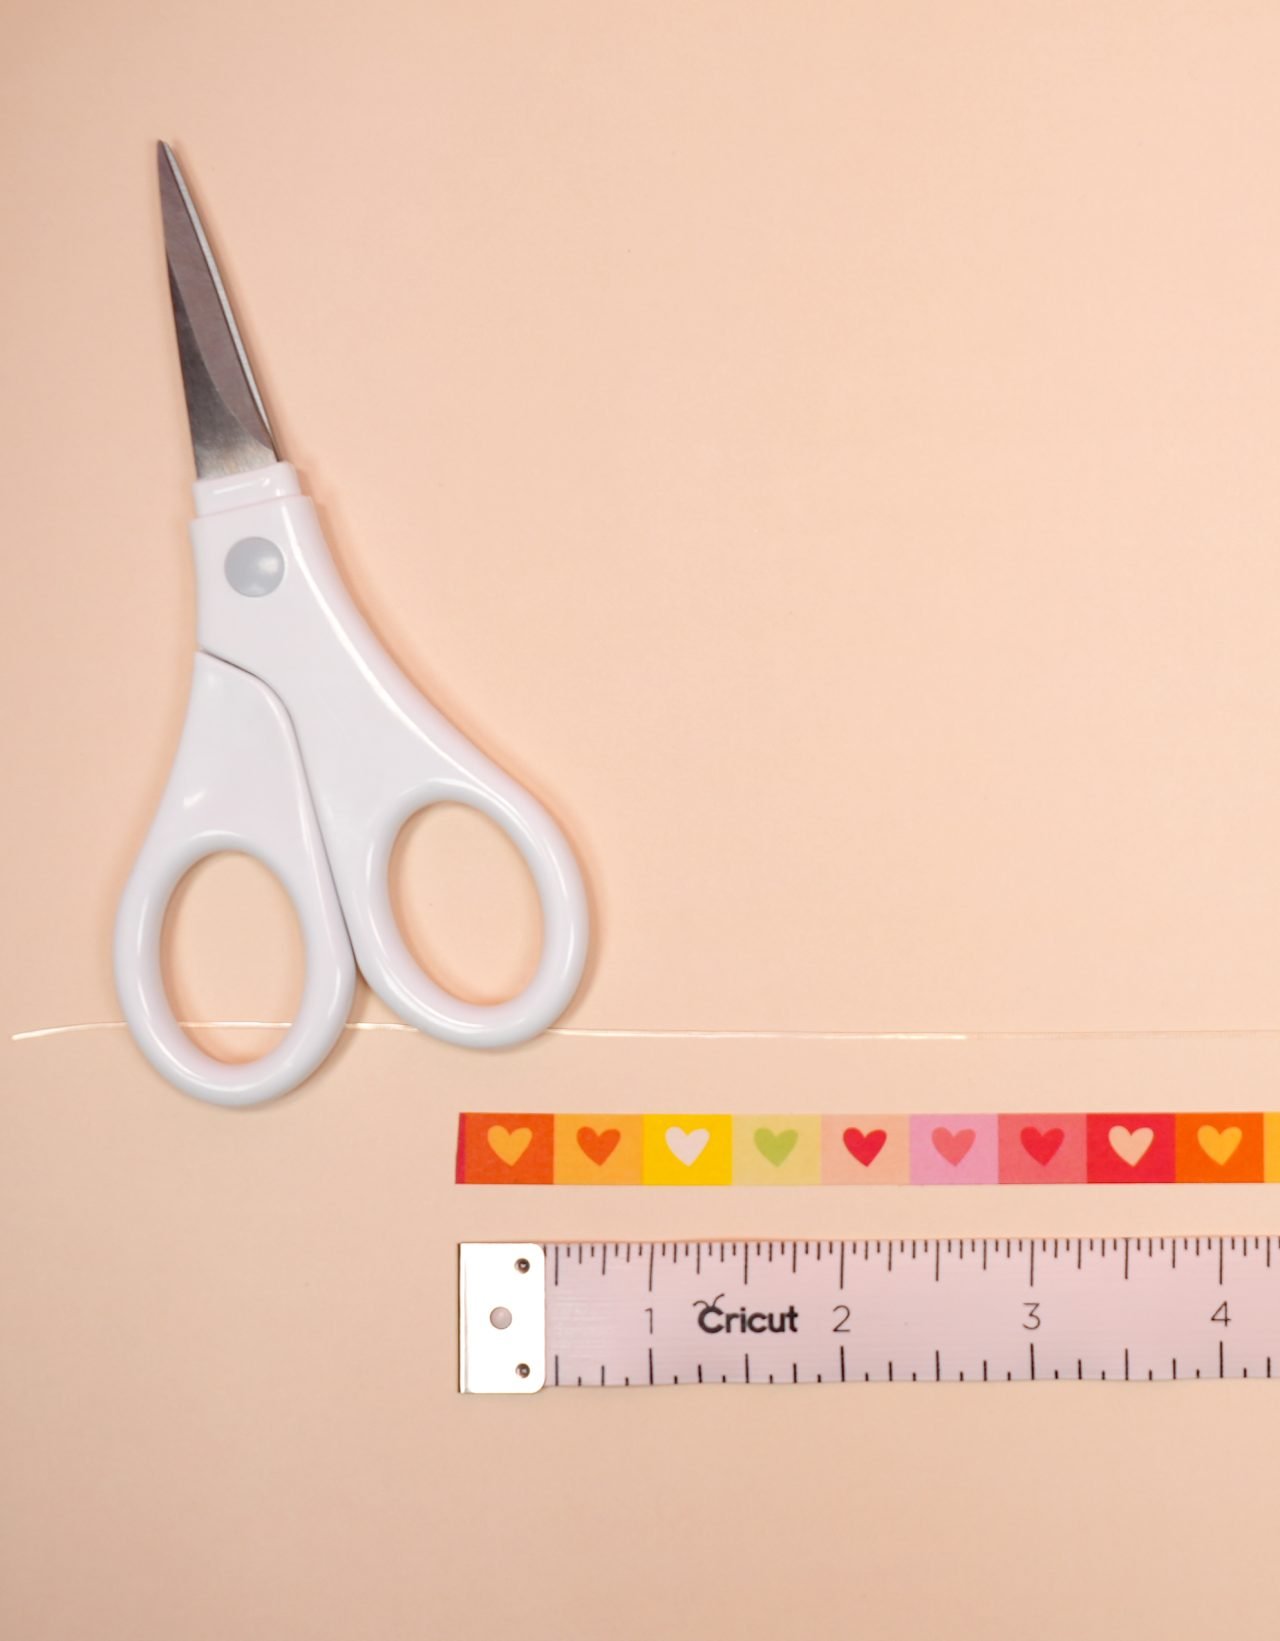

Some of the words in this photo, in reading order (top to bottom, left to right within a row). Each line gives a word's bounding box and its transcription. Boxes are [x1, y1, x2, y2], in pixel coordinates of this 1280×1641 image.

[644, 1307, 654, 1335] 1
[693, 1293, 799, 1334] Cricut
[832, 1304, 851, 1334] 2
[1022, 1302, 1041, 1331] 3
[1210, 1300, 1232, 1328] 4
